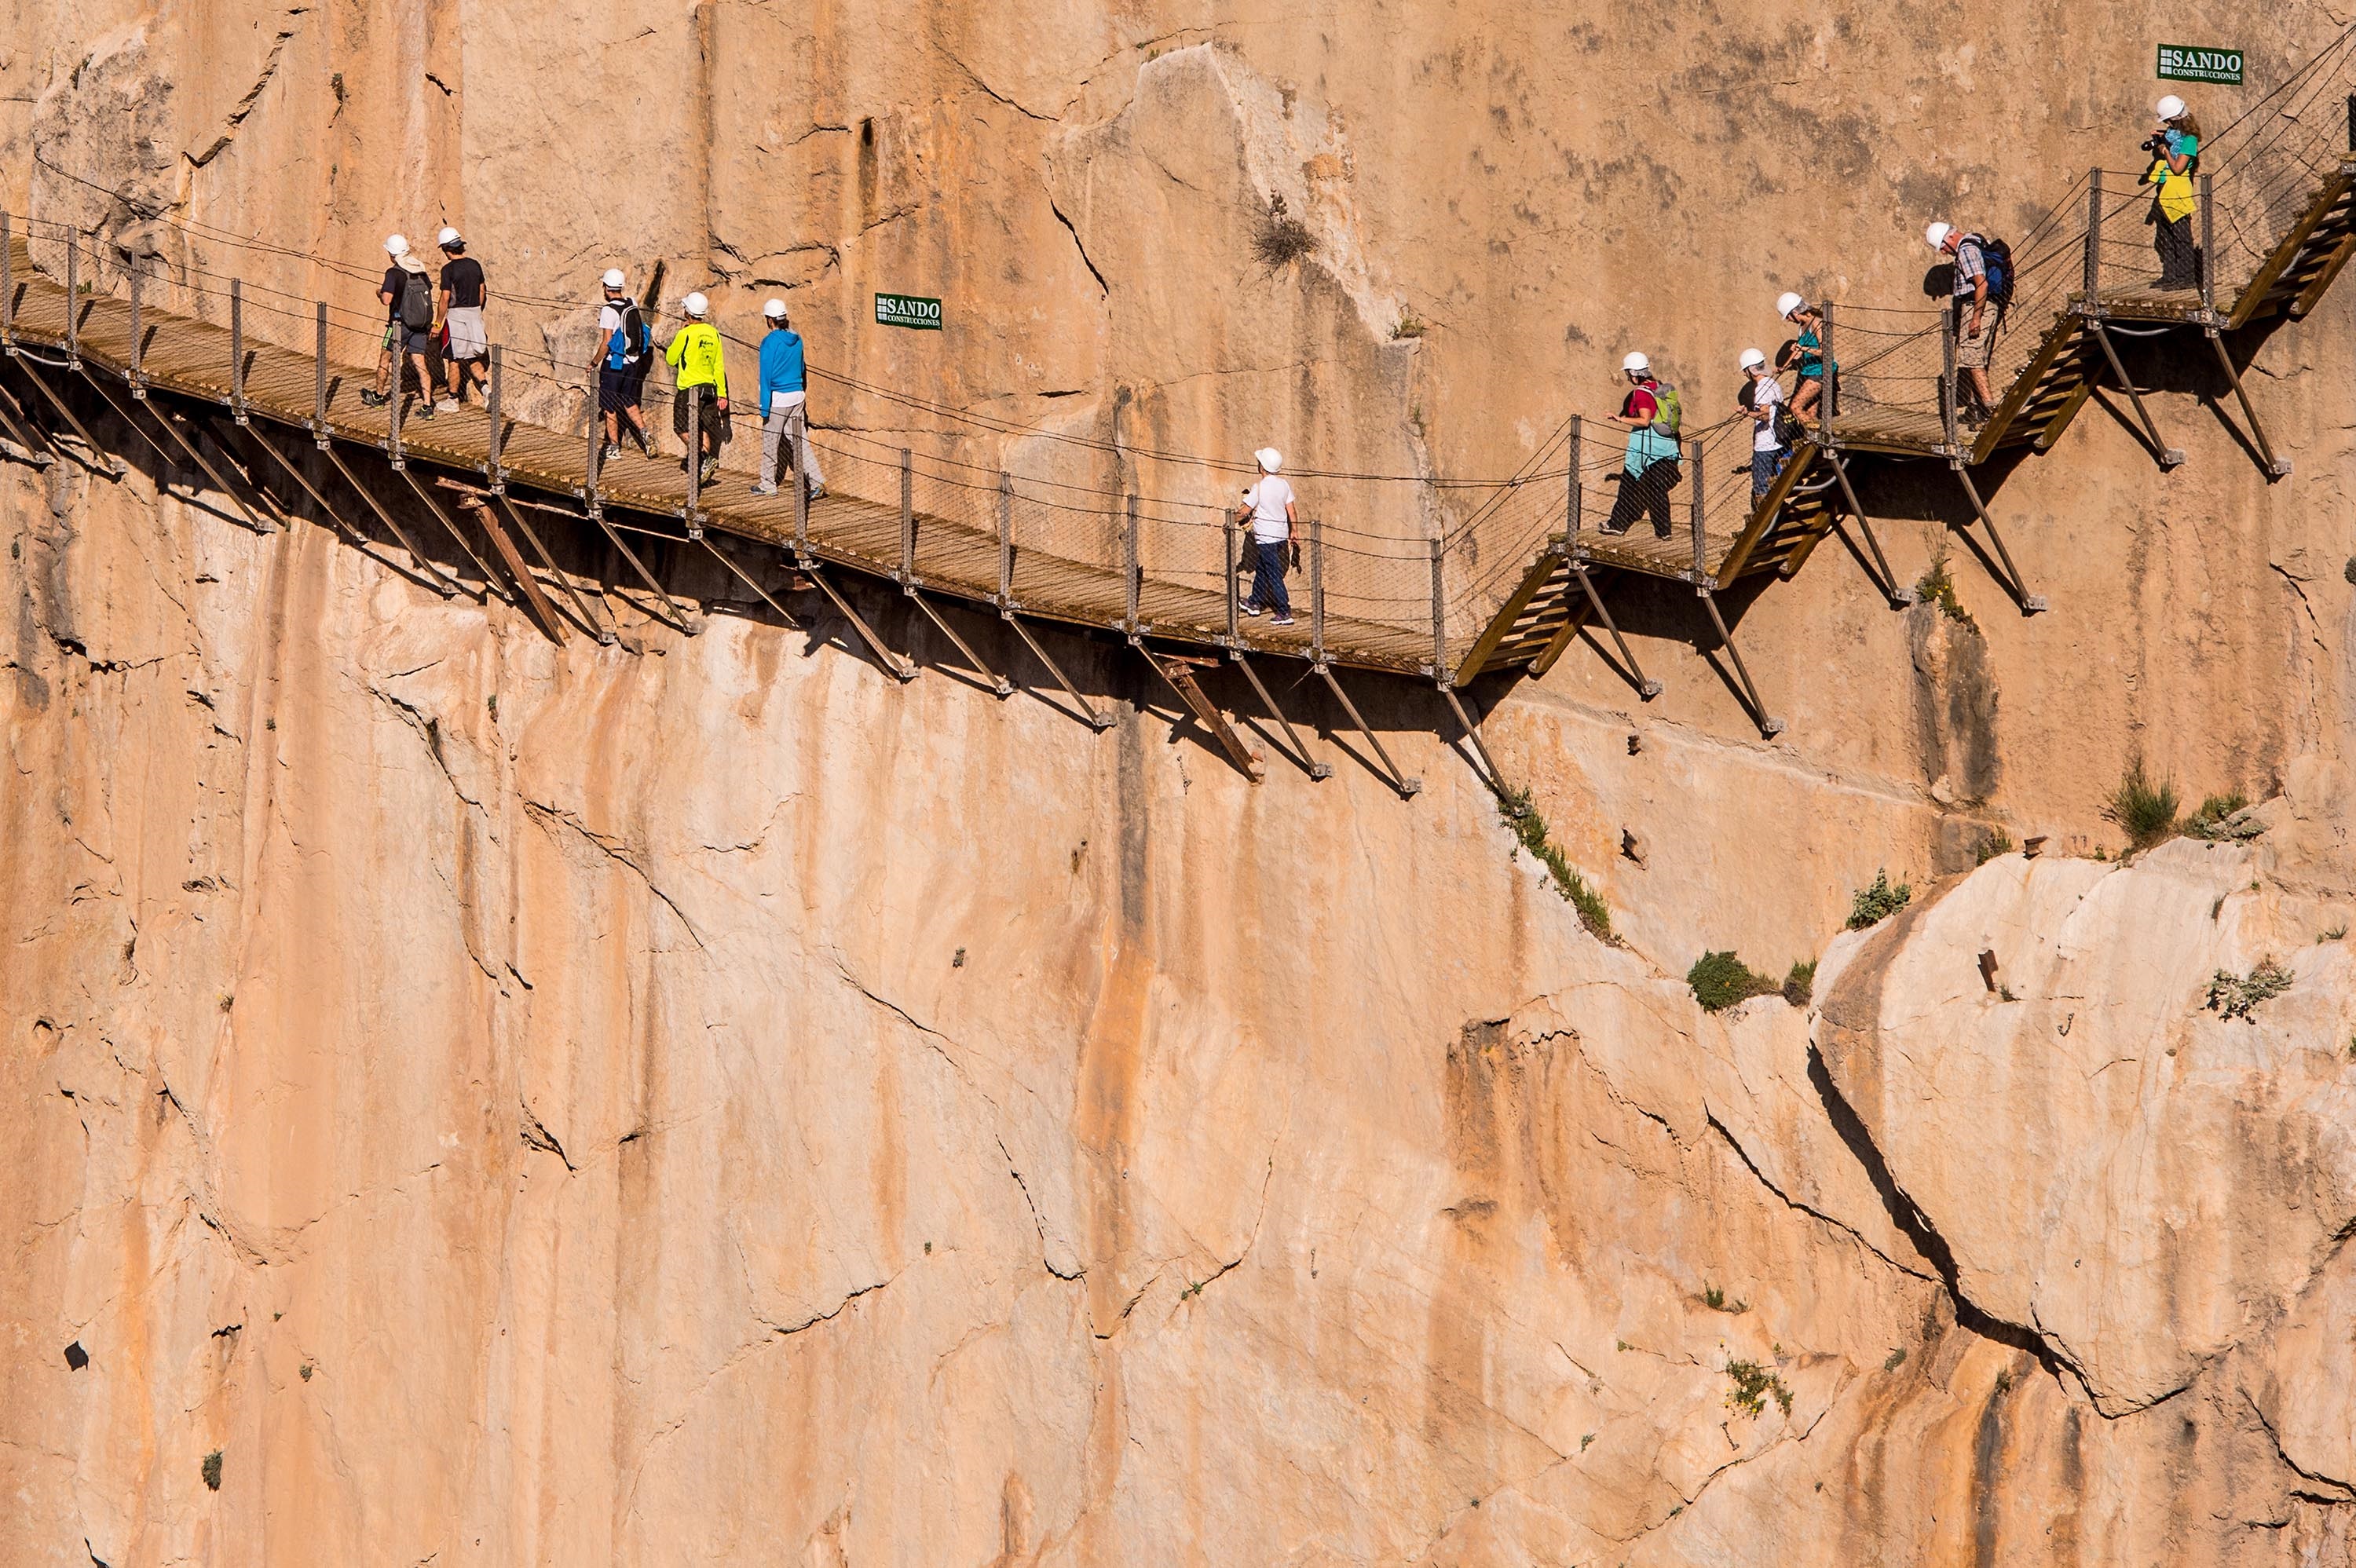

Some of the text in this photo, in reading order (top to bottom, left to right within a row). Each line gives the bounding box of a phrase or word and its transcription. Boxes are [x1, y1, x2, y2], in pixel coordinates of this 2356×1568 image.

[2172, 50, 2241, 72] SANDO
[2172, 68, 2241, 81] CONSTRUCCIONES
[887, 298, 940, 319] SANDO
[887, 315, 941, 327] CONSTRUCCIONES
